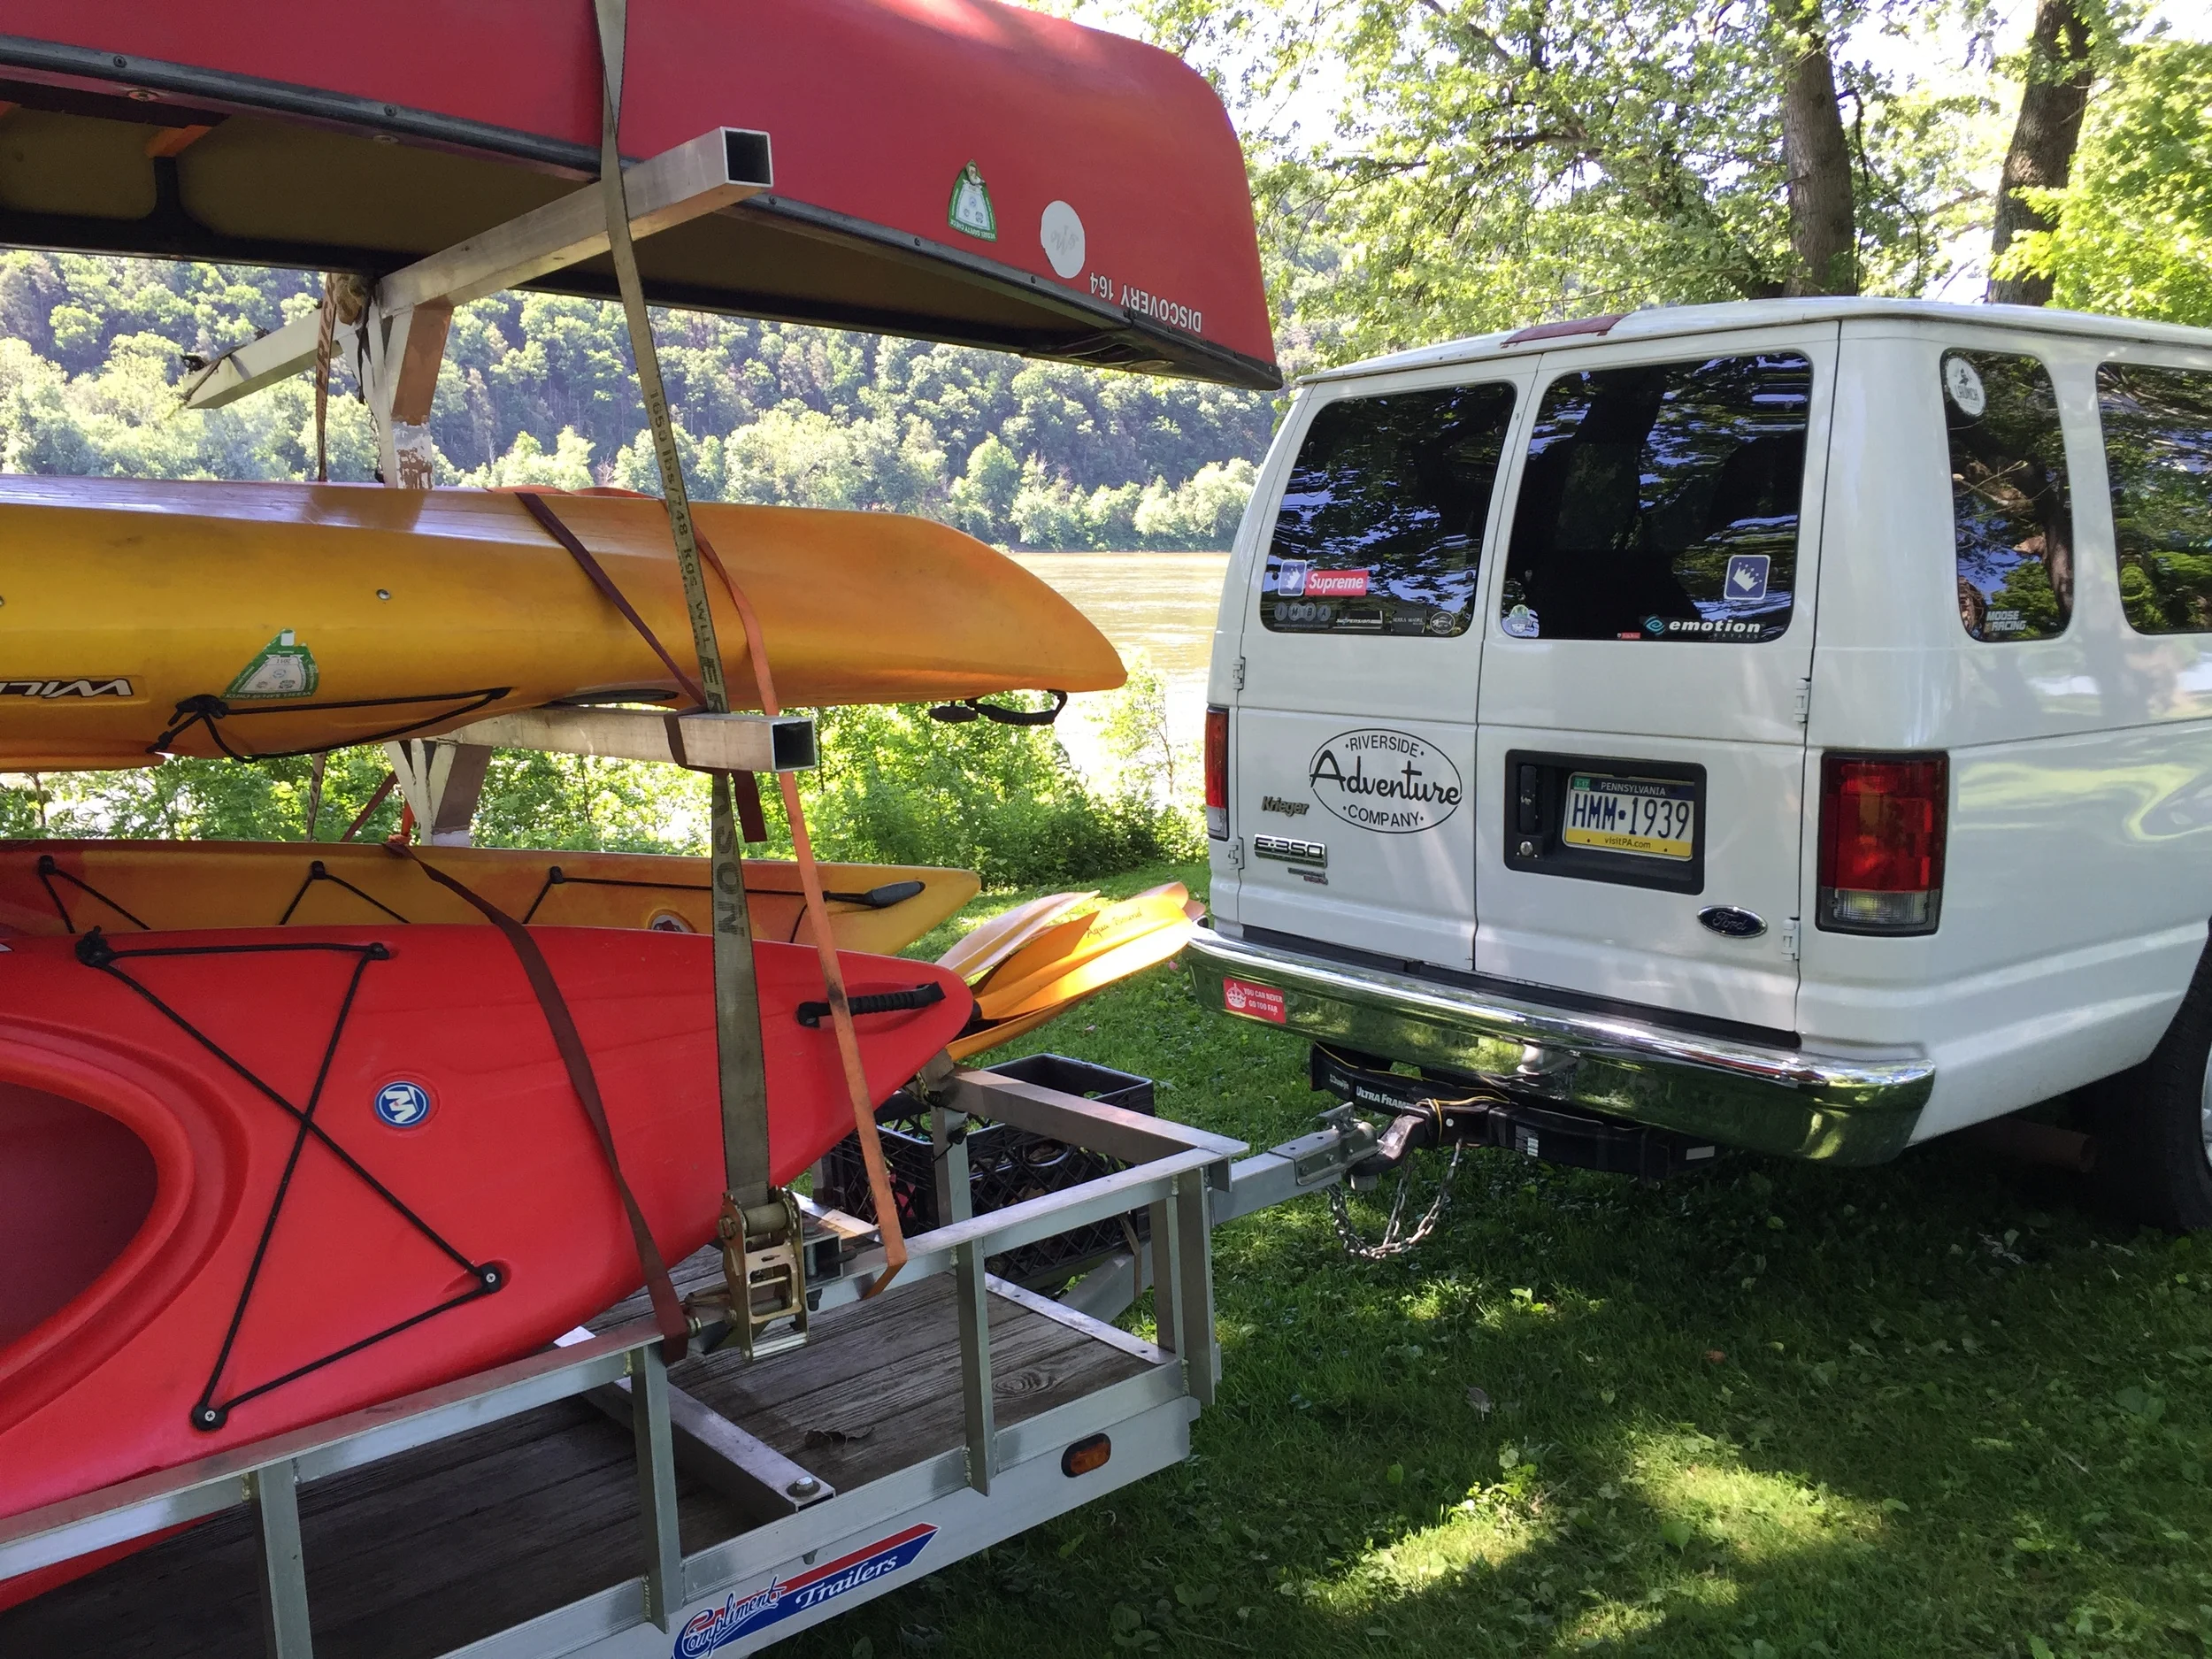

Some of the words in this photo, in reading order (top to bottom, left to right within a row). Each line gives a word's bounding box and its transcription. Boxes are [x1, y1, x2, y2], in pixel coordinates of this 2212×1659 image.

[1089, 272, 1114, 301] 164
[1120, 284, 1202, 333] DISCOVERY
[649, 388, 669, 442] 1650
[682, 548, 698, 587] kgs
[1310, 573, 1363, 594] Supreme
[1986, 611, 2020, 621] MOOSE
[1991, 620, 2027, 632] RACING
[1669, 619, 1761, 634] emotion
[1349, 735, 1420, 757] RIVERSIDE
[1310, 749, 1463, 805] Adventure
[1601, 782, 1666, 795] PENNSYLVANIA
[1262, 795, 1310, 818] Krieger
[1348, 804, 1419, 827] COMPANY
[1604, 836, 1651, 849] visitPA.com
[1712, 911, 1747, 931] Ford
[1087, 925, 1110, 939] Aqua
[1243, 987, 1255, 996] YOU
[1255, 990, 1266, 999] CAN
[1266, 993, 1283, 1003] NEVER
[1256, 1002, 1267, 1010] TOO
[1356, 1085, 1380, 1102] ULTRA
[795, 1555, 897, 1609] Trailers
